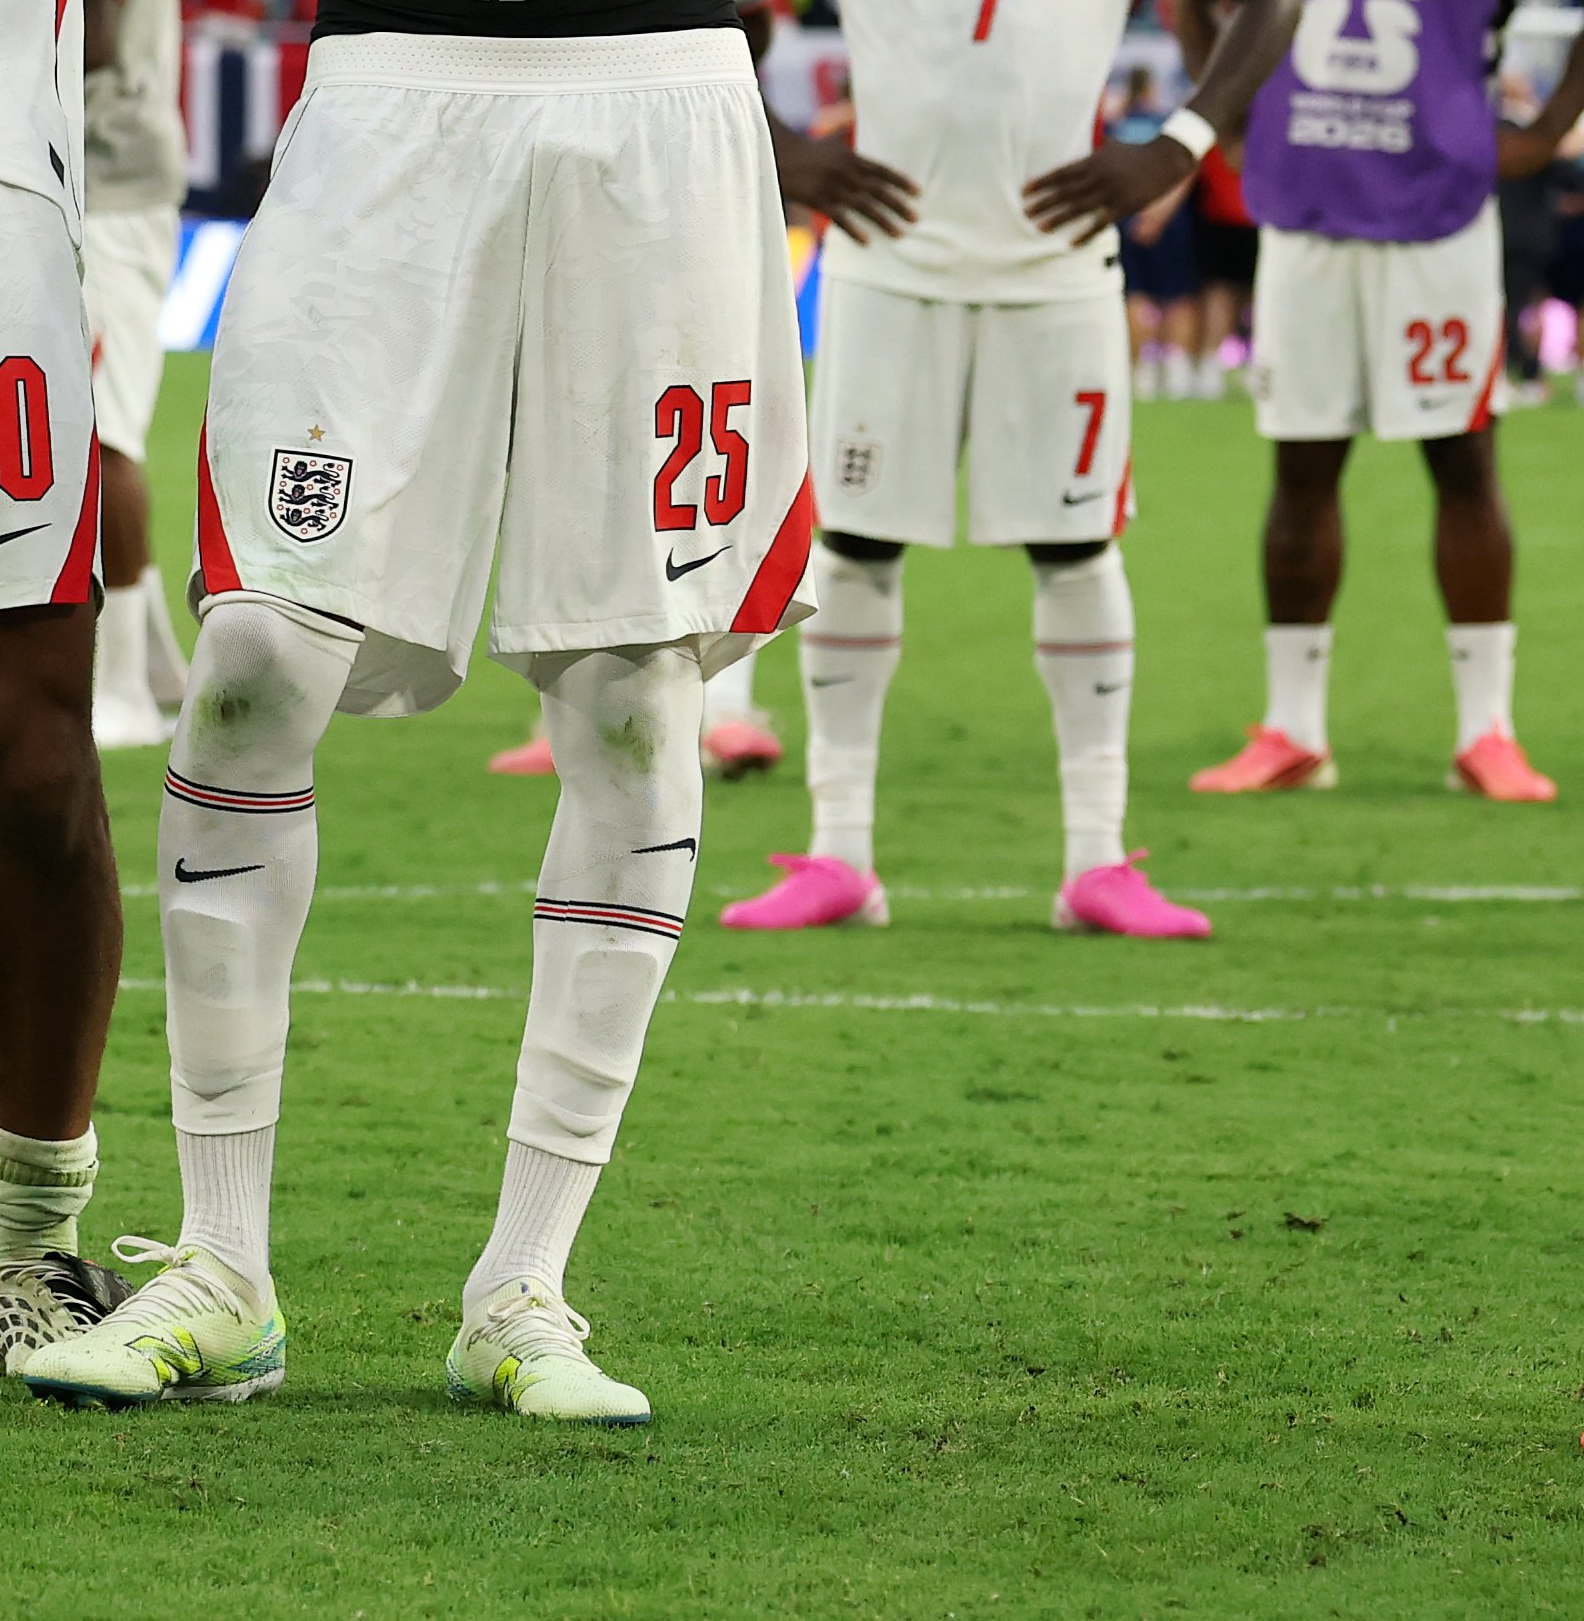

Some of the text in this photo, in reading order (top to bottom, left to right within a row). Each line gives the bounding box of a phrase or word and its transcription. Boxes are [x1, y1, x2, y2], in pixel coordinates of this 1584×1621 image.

[1405, 317, 1470, 386] 22
[653, 379, 752, 532] 25
[1074, 390, 1106, 478] 7
